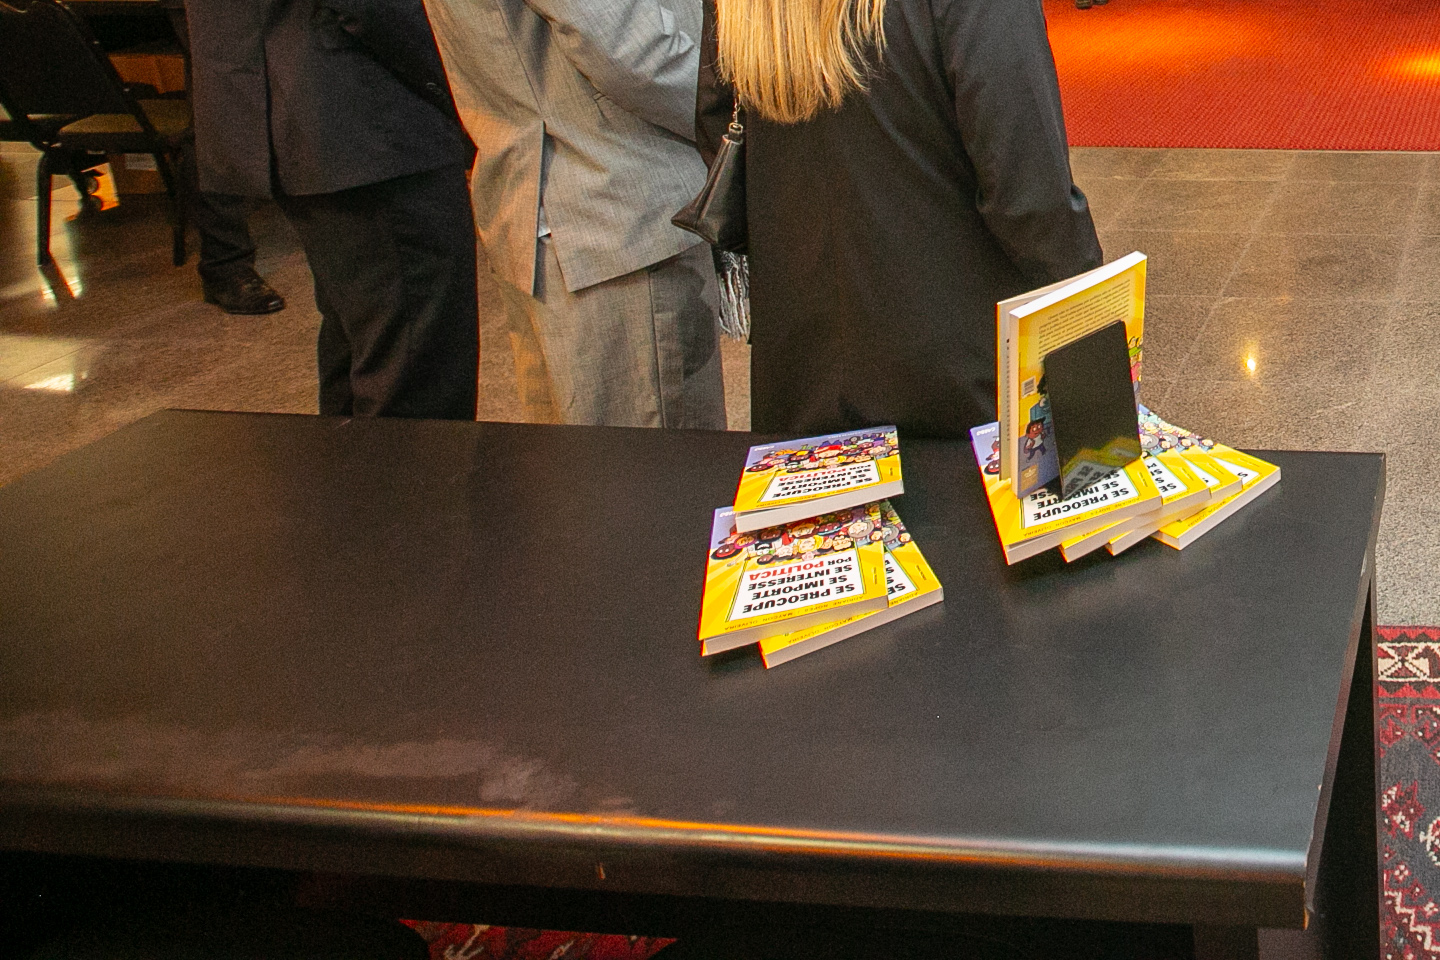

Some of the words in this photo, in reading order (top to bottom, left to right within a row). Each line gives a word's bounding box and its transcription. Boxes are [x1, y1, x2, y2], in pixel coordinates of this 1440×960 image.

[778, 471, 852, 487] INTERESSE
[781, 477, 846, 492] IMPORTE
[1101, 480, 1120, 491] SE
[772, 481, 851, 499] PREOCUPE
[1111, 488, 1129, 498] SE
[1033, 494, 1108, 521] PREOCUPE
[827, 556, 852, 566] POR
[749, 560, 824, 581] POLÍTICA
[834, 564, 853, 574] SE
[748, 568, 831, 591] INTERESSE
[829, 574, 848, 585] SE
[752, 580, 824, 601] IMPORTE
[836, 583, 855, 594] SE
[742, 590, 831, 614] PREOCUPE
[724, 619, 758, 631] OLIVEIRA
